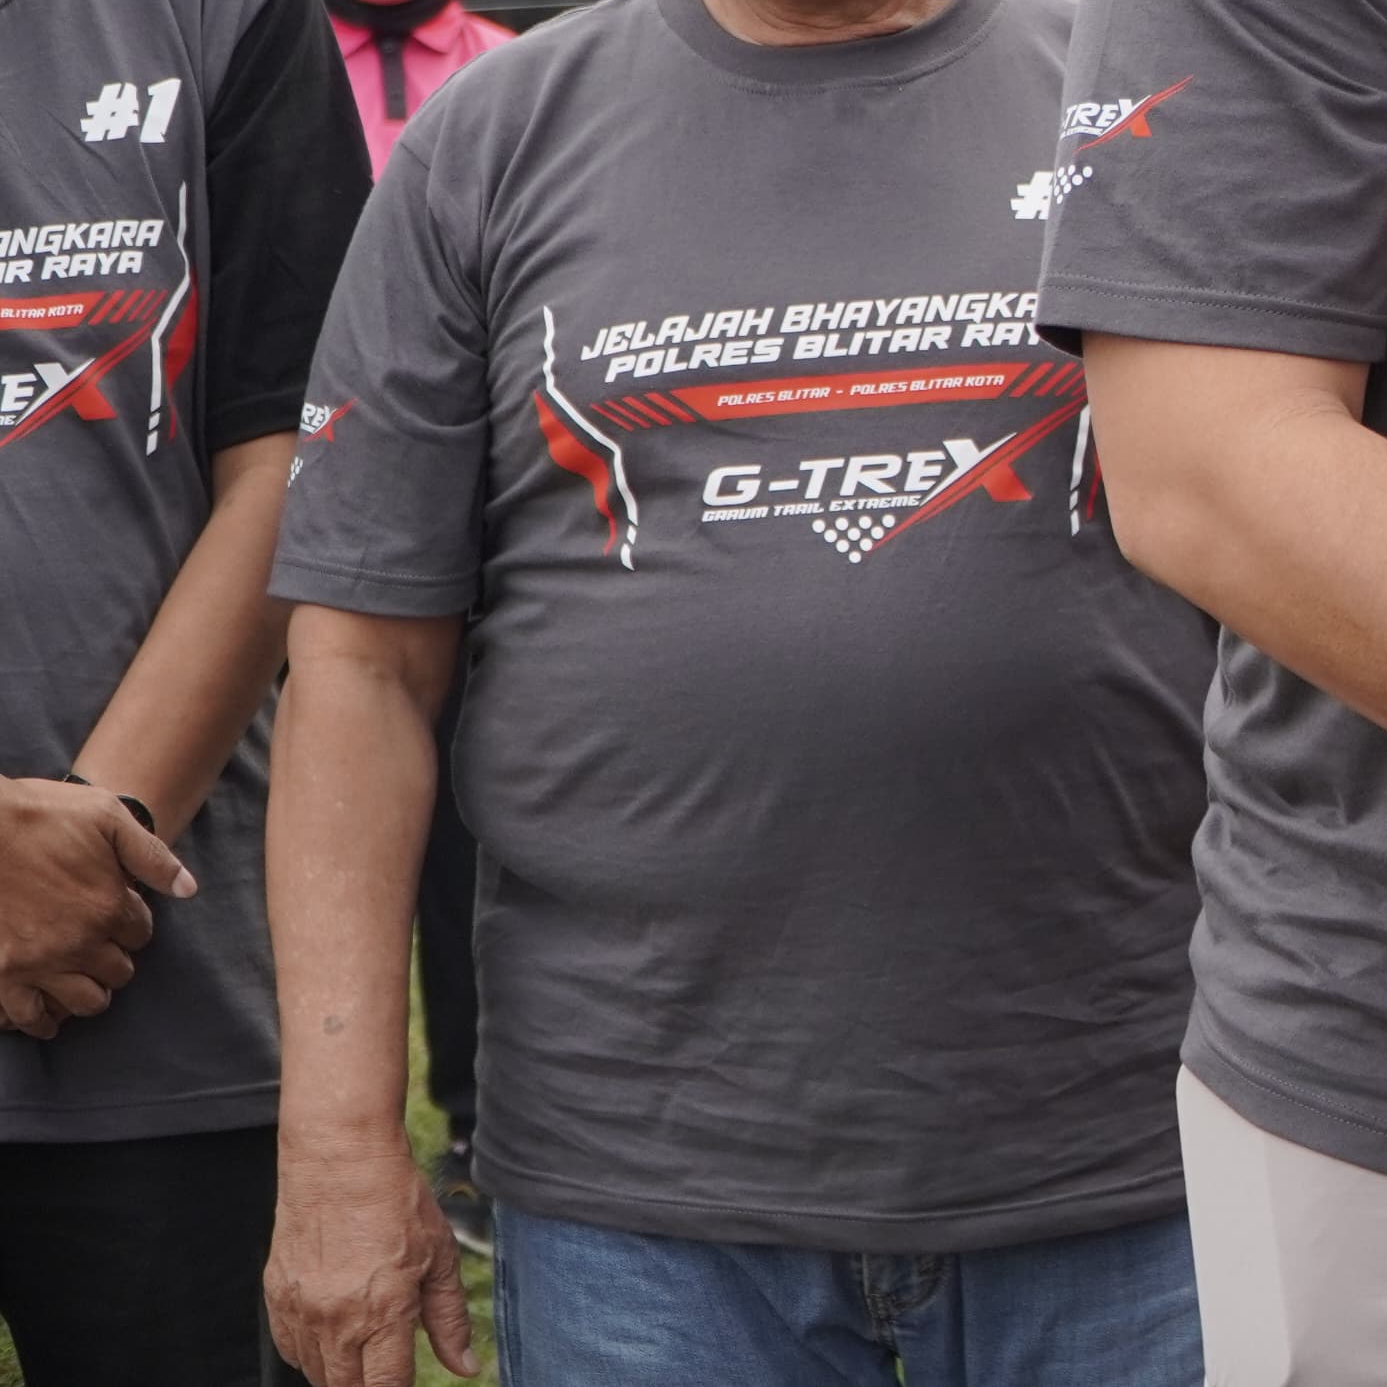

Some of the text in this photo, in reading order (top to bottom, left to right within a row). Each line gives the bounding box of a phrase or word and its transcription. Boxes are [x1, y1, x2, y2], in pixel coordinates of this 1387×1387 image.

[80, 78, 181, 143] #1
[1063, 95, 1152, 138] TREX
[0, 220, 163, 258] NGKARA
[41, 251, 143, 280] RAYA
[48, 304, 83, 317] KOTA
[580, 292, 1037, 361] JELAJAH BHAYANGKA
[605, 322, 1040, 382] POLRES BLITAR RAY
[717, 391, 775, 406] POLRES
[777, 387, 831, 402] BLITAR
[850, 381, 908, 396] POLRES
[910, 377, 963, 391] BLITAR
[965, 375, 1005, 386] KOTA
[702, 433, 1031, 507] G-TREX
[771, 502, 824, 516] TRAIL
[829, 494, 921, 512] EXTREME
